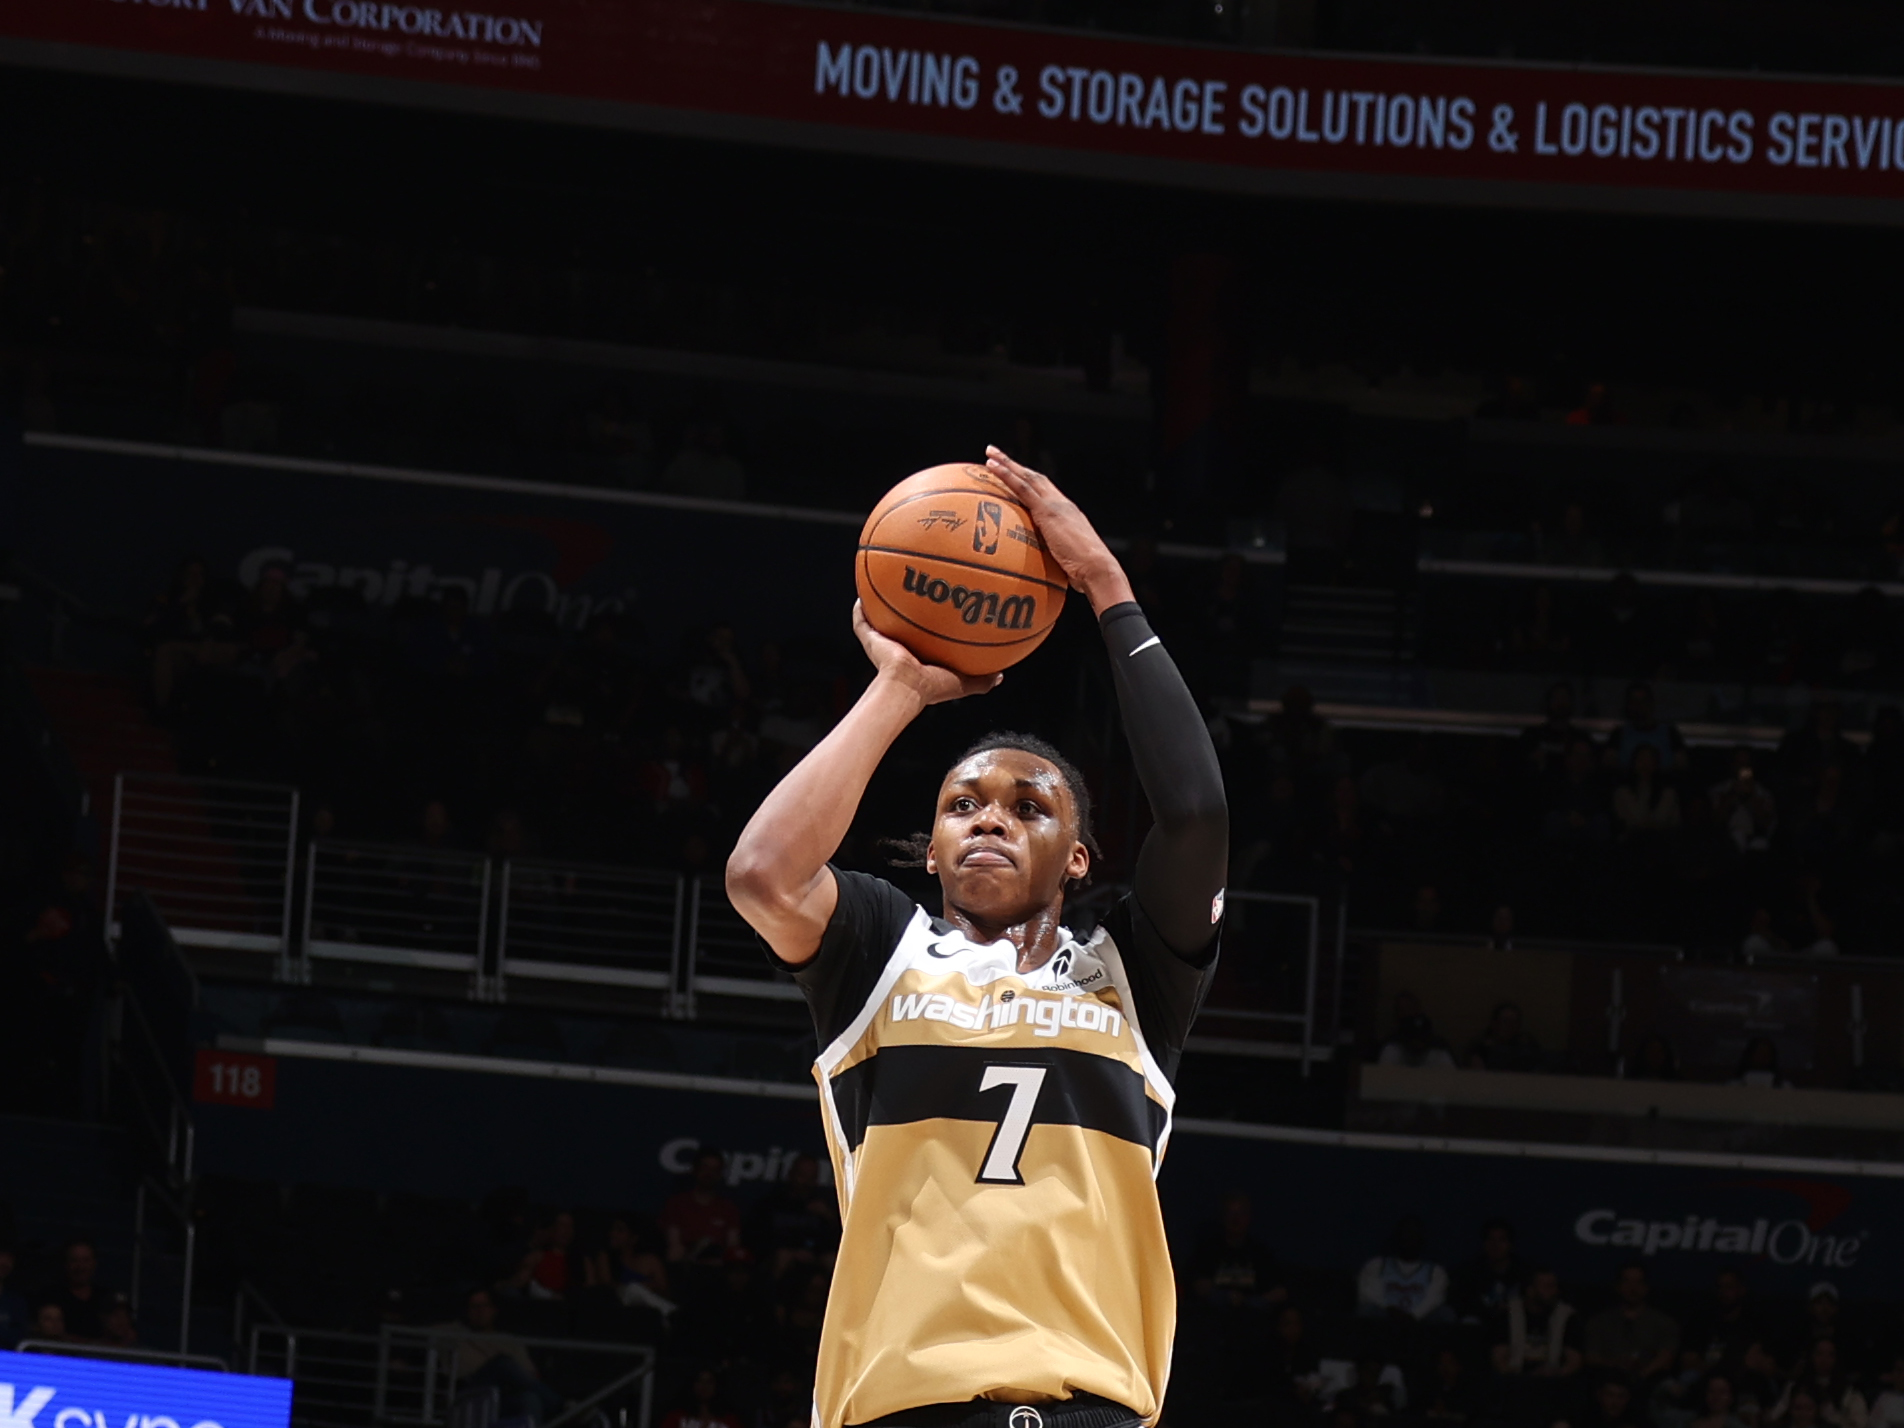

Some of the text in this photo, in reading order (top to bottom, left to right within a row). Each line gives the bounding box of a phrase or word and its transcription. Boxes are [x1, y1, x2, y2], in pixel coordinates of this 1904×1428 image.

[303, 0, 543, 48] CORPORATION
[814, 40, 982, 110] MOVING
[992, 64, 1024, 116] &
[1036, 64, 1228, 135] STORAGE
[1237, 82, 1477, 151] SOLUTIONS
[1487, 102, 1520, 155] &
[1533, 100, 1756, 165] LOGISTICS
[902, 565, 1036, 630] Wilson
[891, 990, 1121, 1037] washington
[209, 1062, 262, 1098] 118
[976, 1062, 1051, 1185] 7
